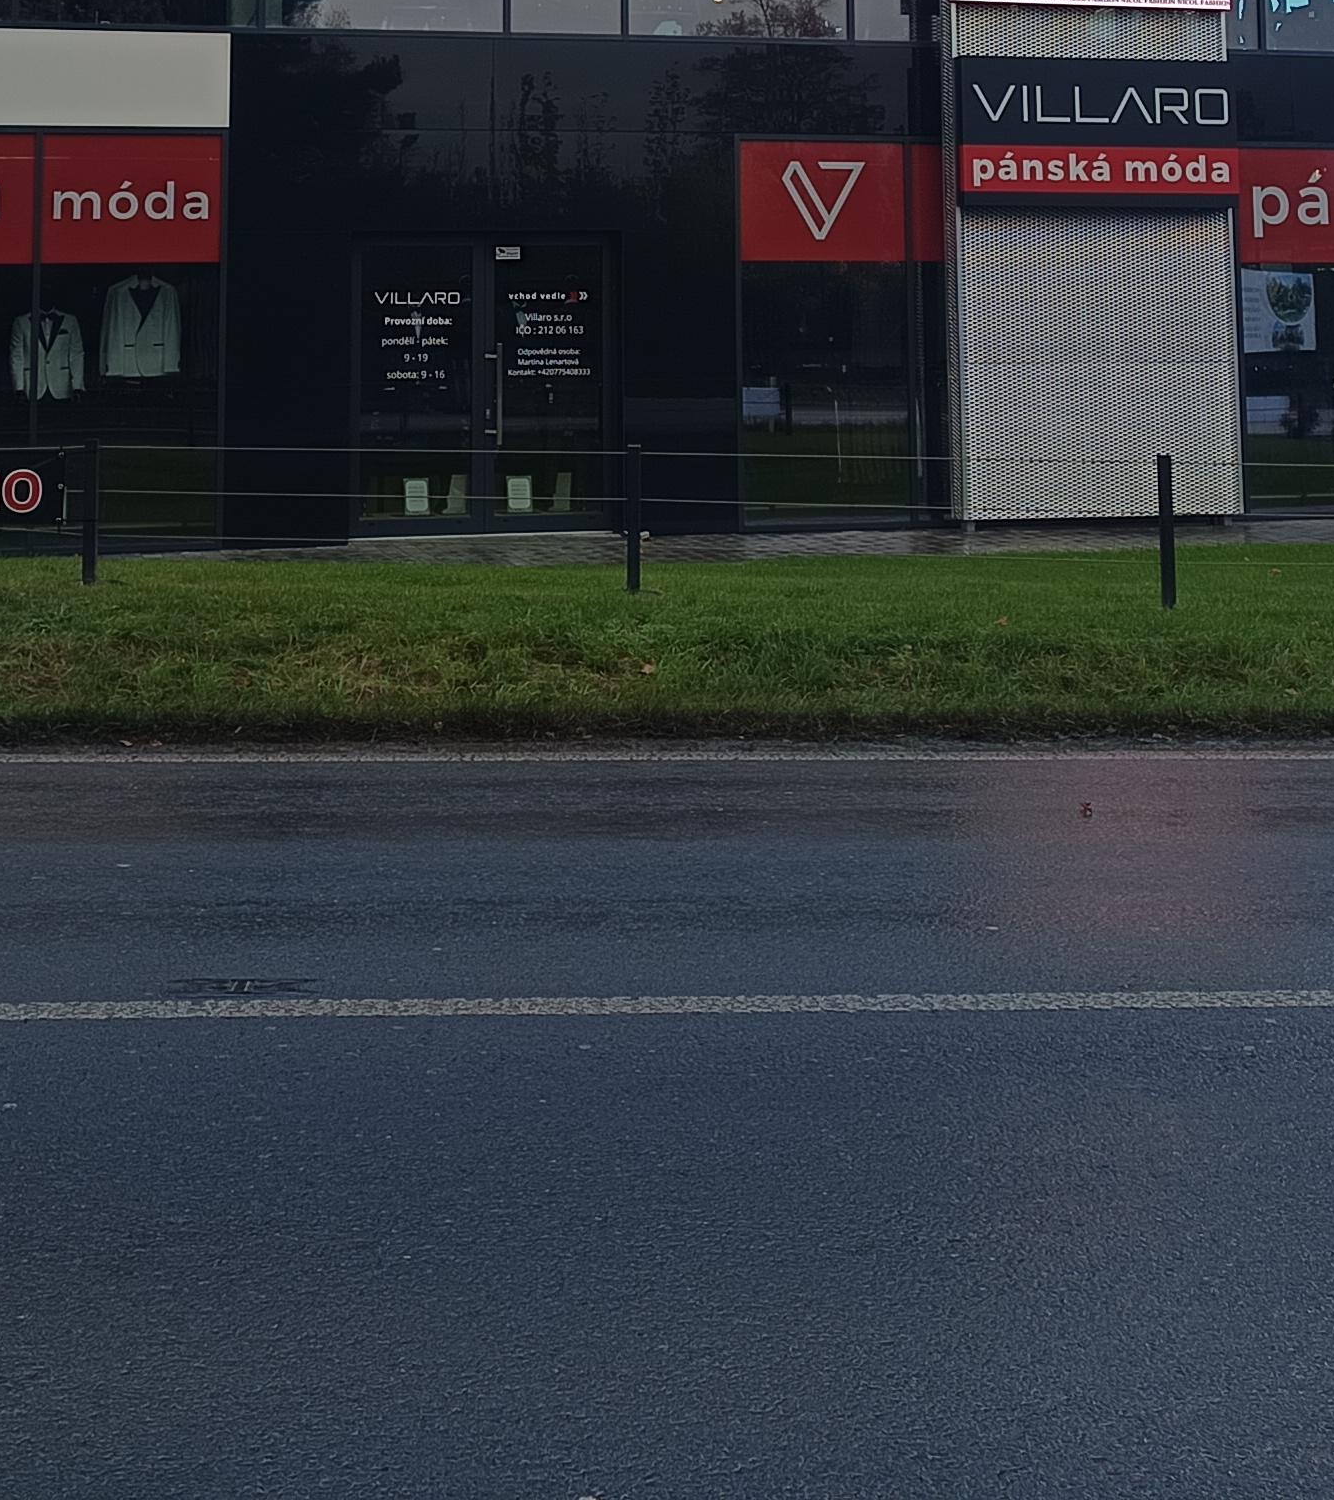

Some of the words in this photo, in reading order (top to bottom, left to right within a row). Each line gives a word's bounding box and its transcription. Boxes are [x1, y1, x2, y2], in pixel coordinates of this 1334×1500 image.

[972, 84, 1229, 125] VILLARO
[972, 151, 1111, 187] pánská
[1125, 154, 1230, 183] móda
[52, 180, 209, 221] móda
[374, 291, 461, 305] VILLARO
[508, 291, 537, 300] vchod
[540, 291, 566, 300] vedle
[384, 316, 425, 326] Provozní
[426, 316, 453, 326] doba:
[524, 312, 552, 322] Villaro
[538, 325, 553, 335] 212
[555, 325, 566, 335] 06
[569, 325, 584, 335] 163
[381, 336, 415, 348] pondělí
[421, 336, 449, 348] pátek:
[403, 353, 410, 363] 9
[417, 353, 429, 362] 19
[386, 370, 419, 380] sobota:
[420, 370, 427, 379] 9
[435, 370, 446, 379] 16
